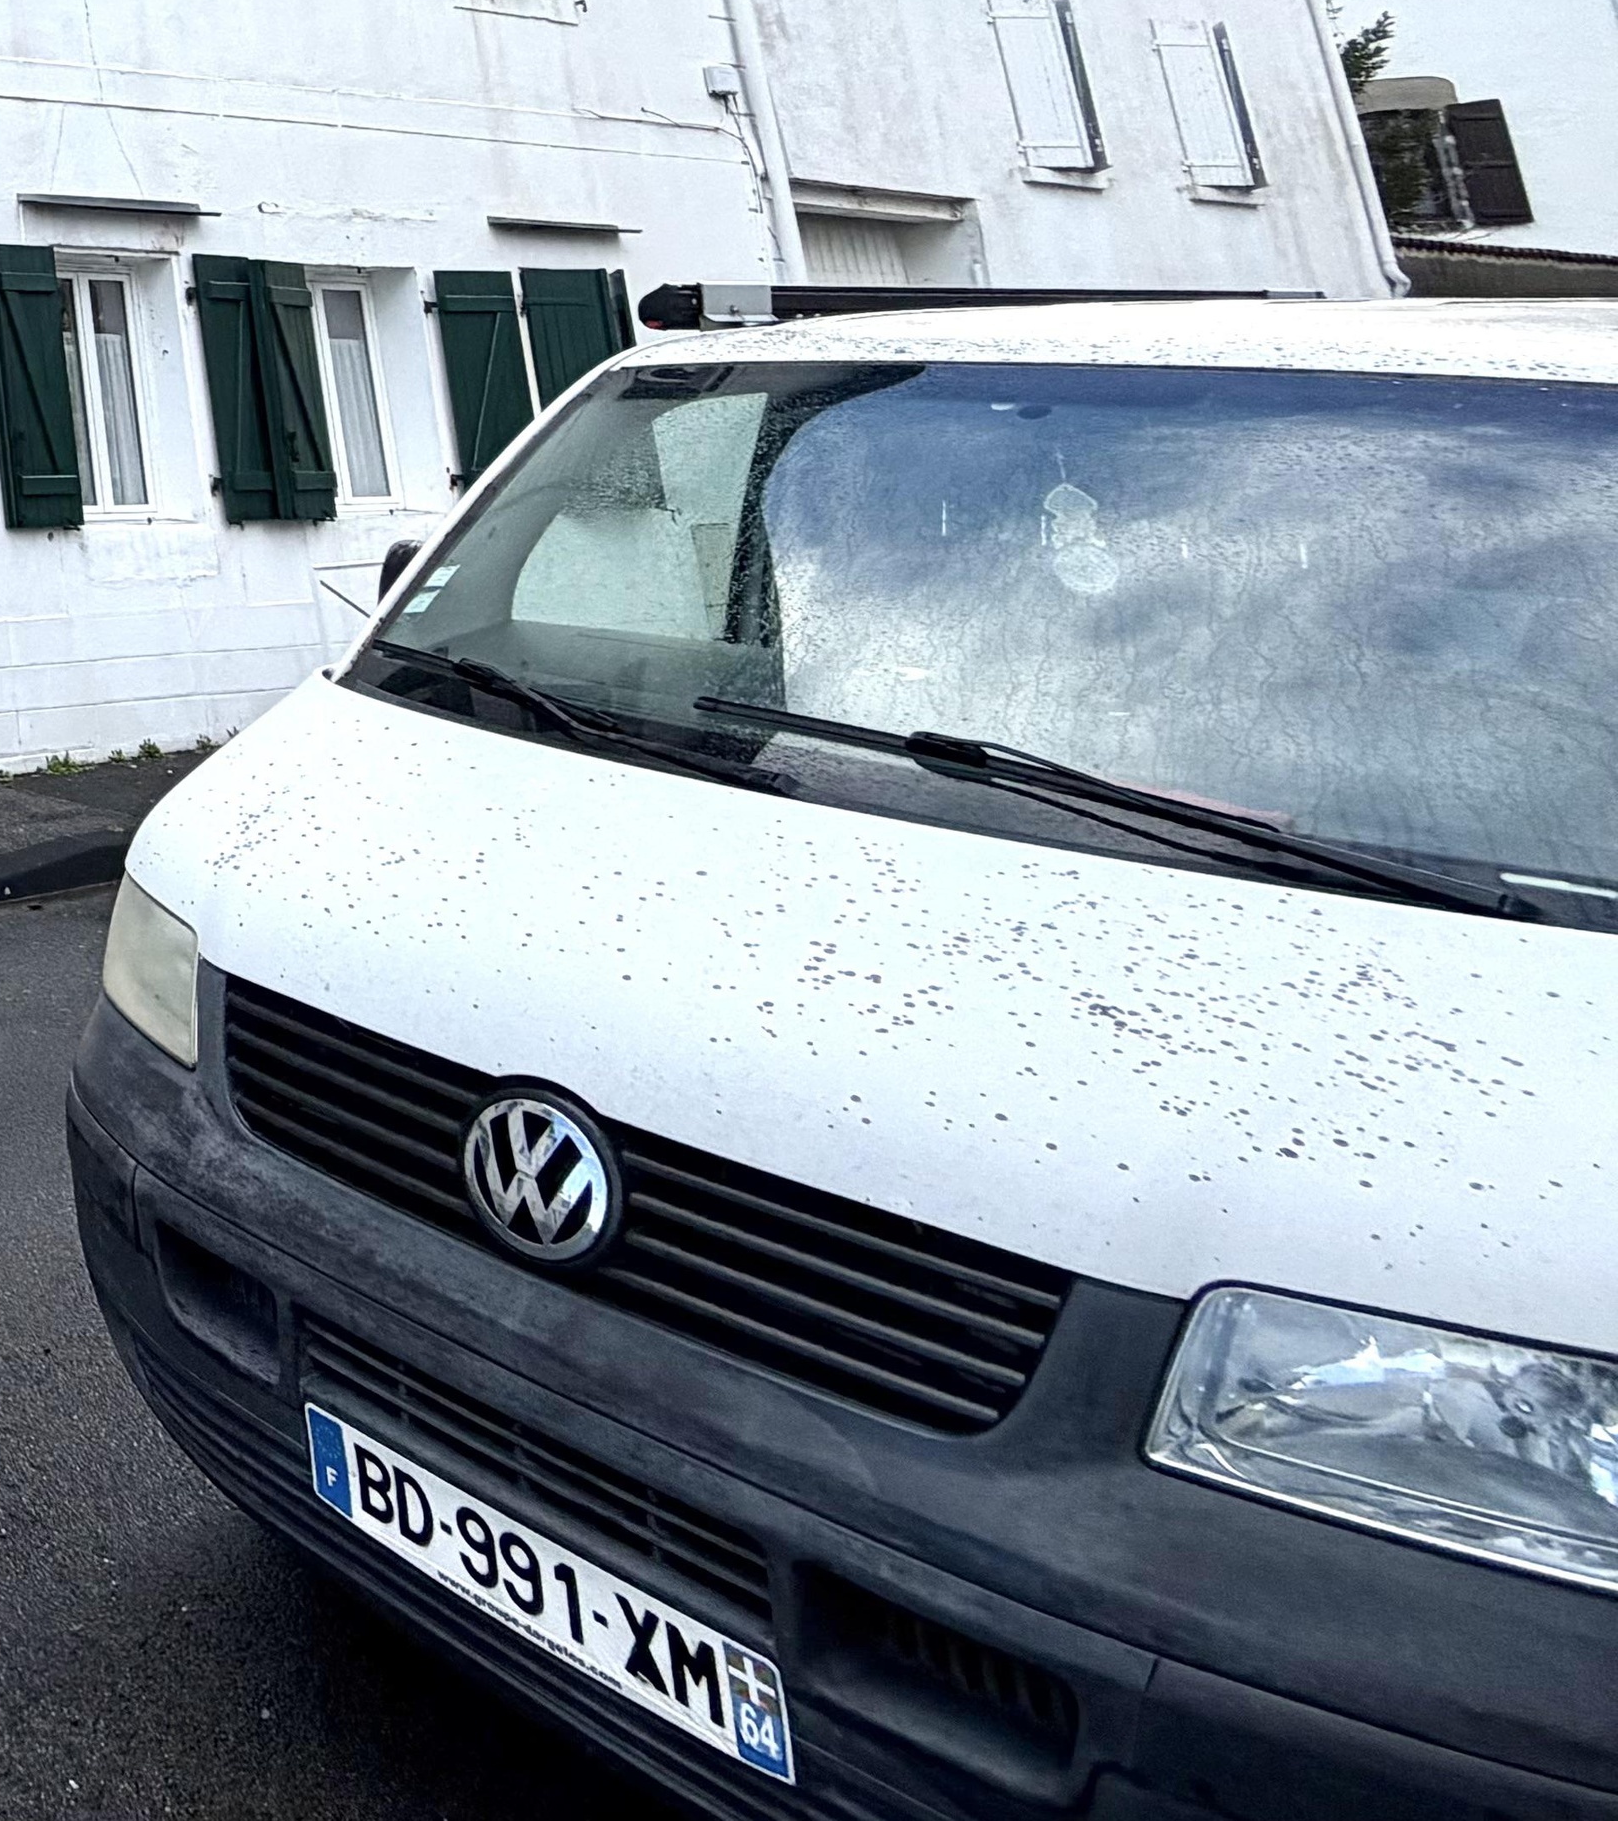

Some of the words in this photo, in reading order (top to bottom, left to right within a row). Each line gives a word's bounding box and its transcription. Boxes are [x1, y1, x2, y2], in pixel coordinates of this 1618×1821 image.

[325, 1465, 339, 1488] F
[353, 1442, 726, 1729] BD-991-XM
[739, 1702, 781, 1760] 64
